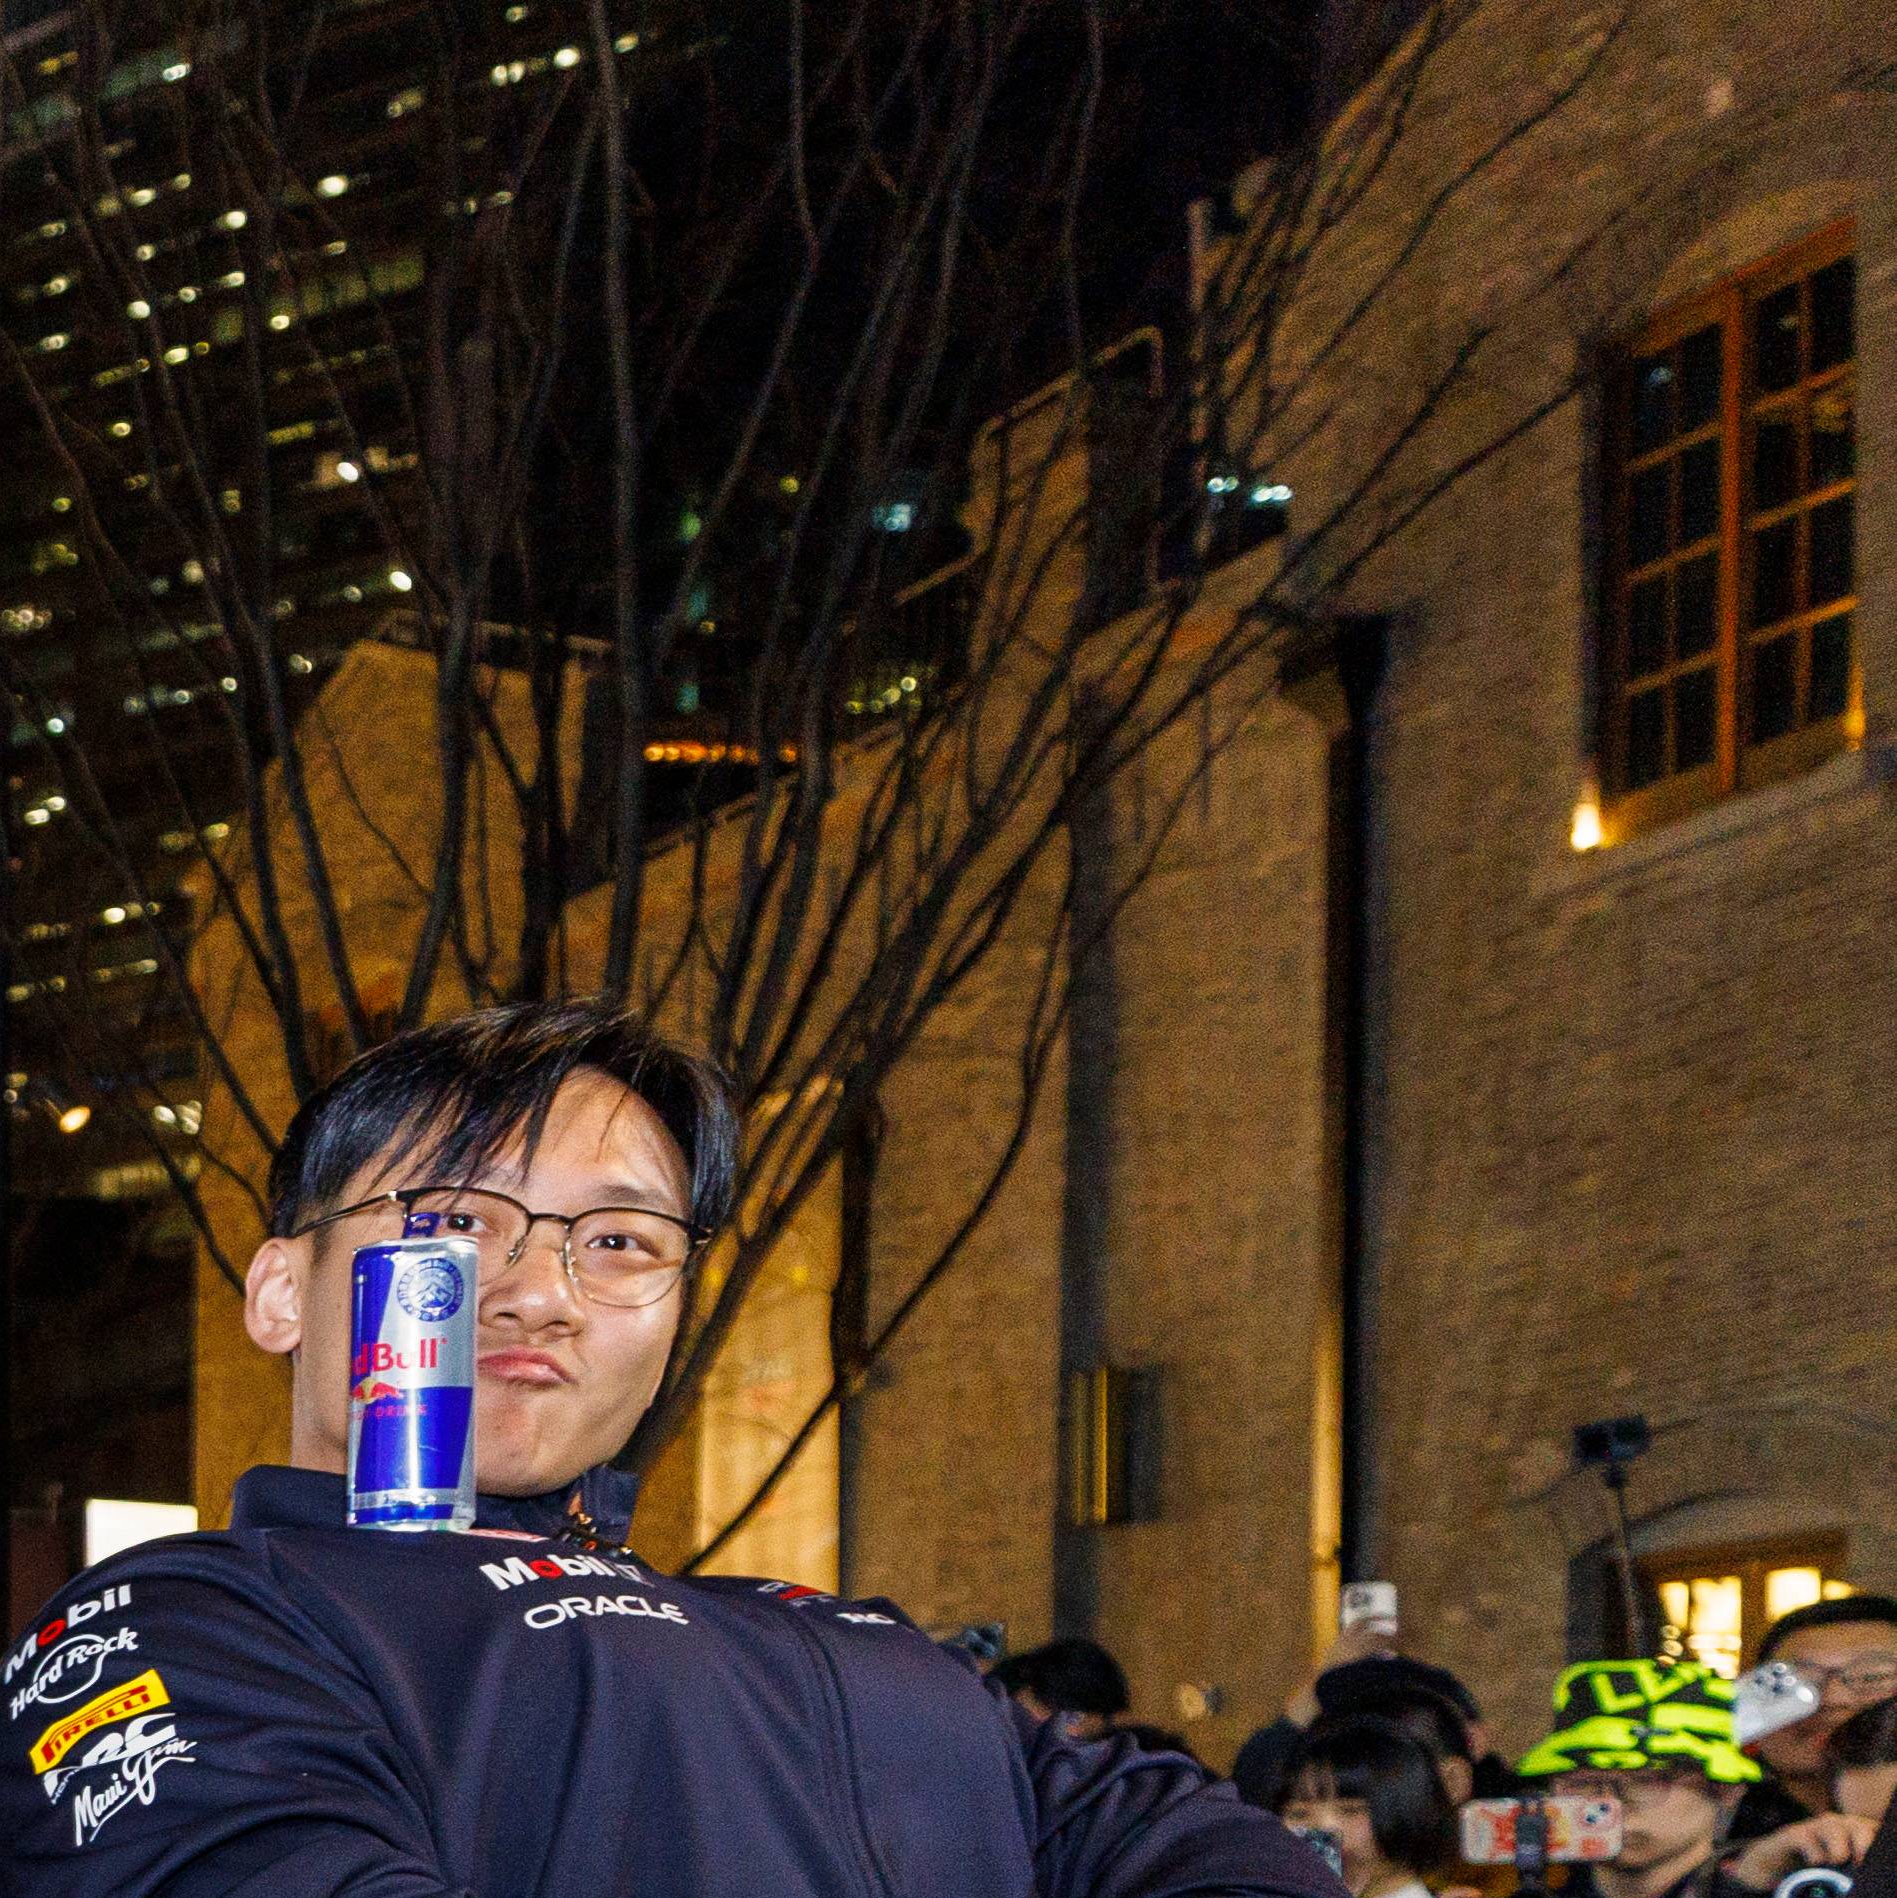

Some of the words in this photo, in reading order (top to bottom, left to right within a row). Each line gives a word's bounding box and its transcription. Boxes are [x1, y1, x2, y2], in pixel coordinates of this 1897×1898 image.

[480, 1554, 617, 1590] Mobil
[5, 1584, 131, 1684] Mobil
[524, 1595, 690, 1629] ORACLE
[10, 1655, 63, 1721] Hard
[67, 1627, 139, 1669] Rock
[40, 1684, 151, 1764] PIRELLI
[74, 1773, 128, 1847] Maui
